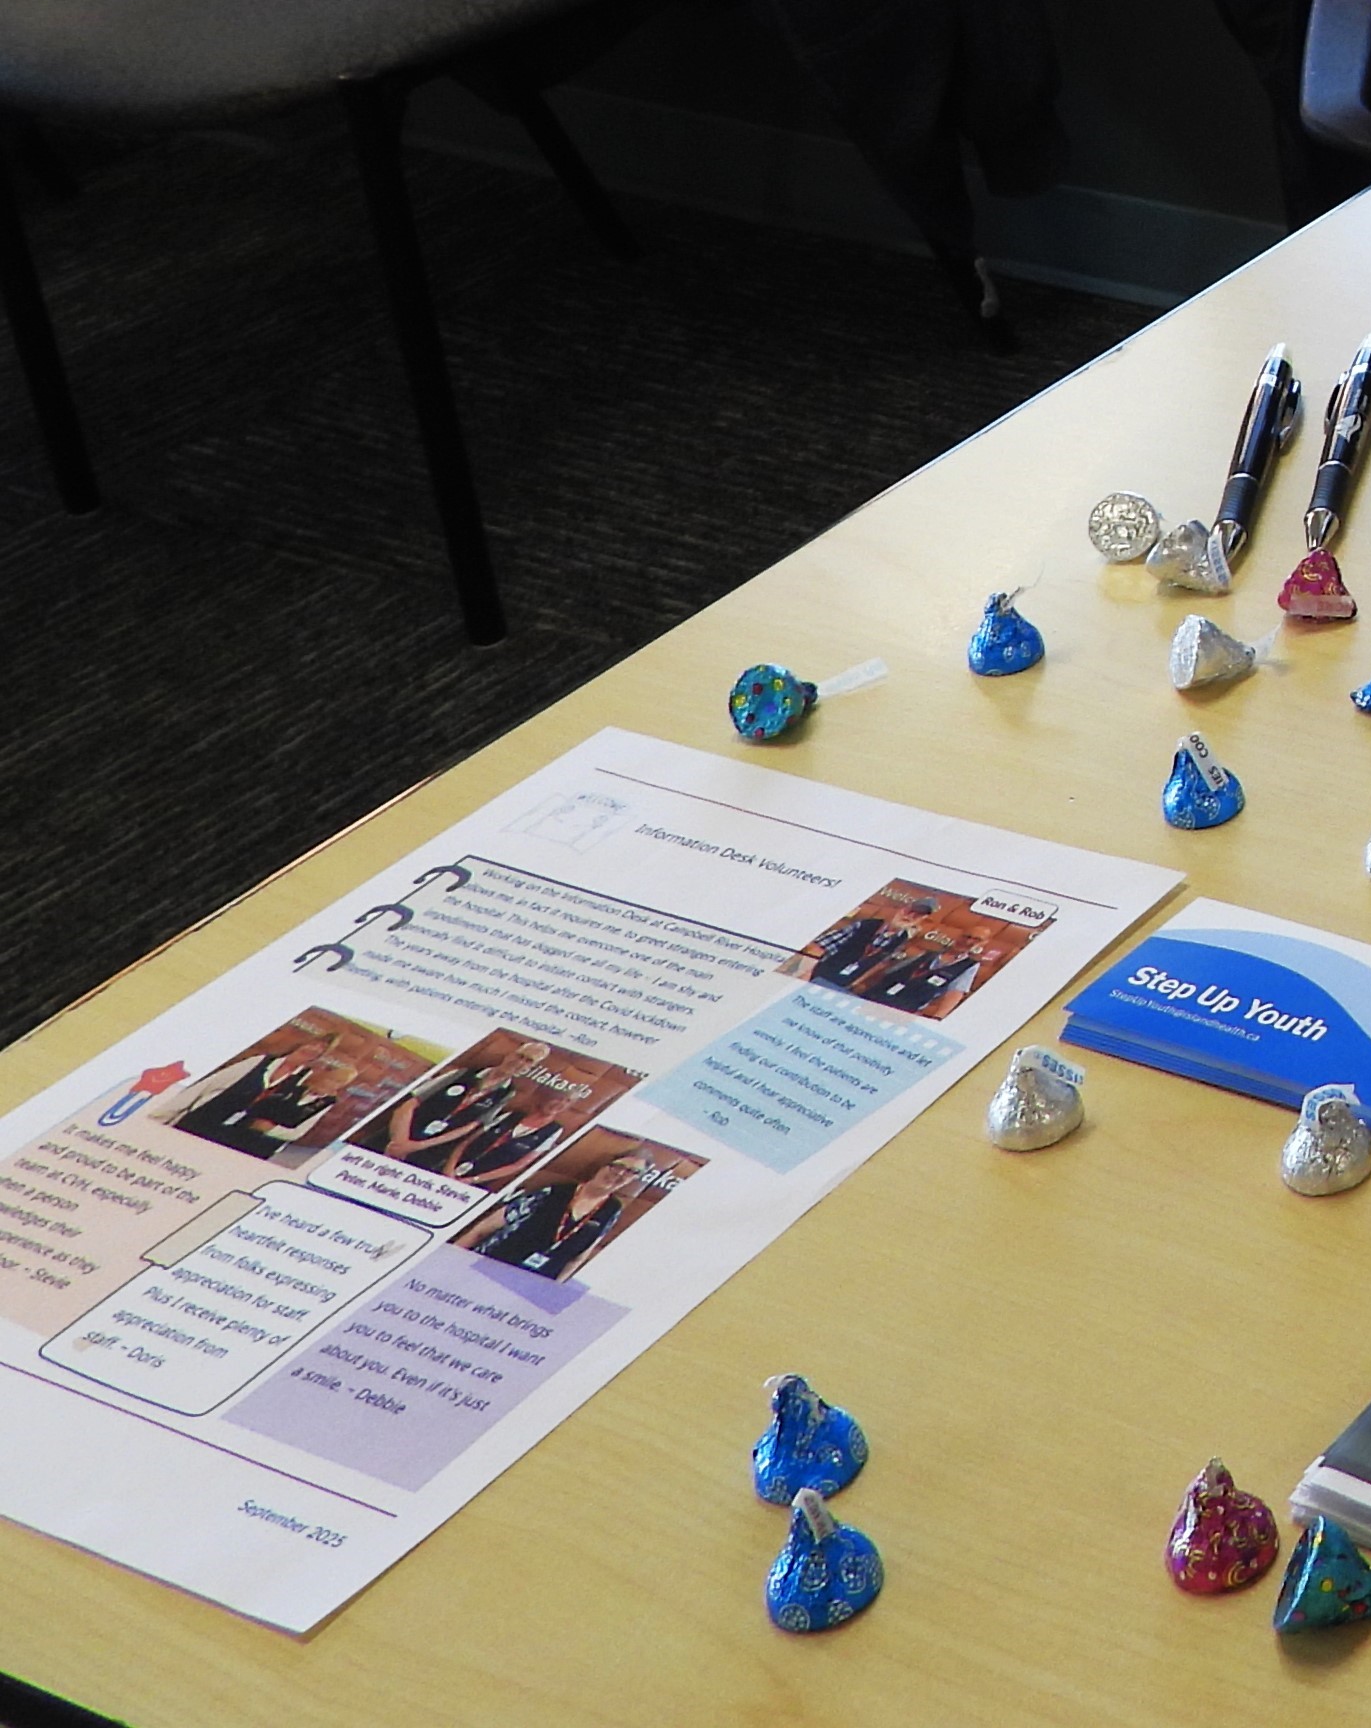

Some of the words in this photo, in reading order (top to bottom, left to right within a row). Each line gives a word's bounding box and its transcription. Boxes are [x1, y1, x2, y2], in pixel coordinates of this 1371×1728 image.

[634, 823, 720, 854] Information
[719, 847, 756, 864] Desk
[980, 897, 1007, 910] Ron
[1006, 903, 1020, 913] &
[1018, 906, 1045, 923] Rob
[1127, 966, 1197, 1000] Step
[1196, 985, 1240, 1013] Up
[1243, 998, 1327, 1041] Youth
[341, 1152, 364, 1166] left
[360, 1159, 375, 1169] to
[401, 1192, 443, 1212] Debbie
[229, 1222, 287, 1252] heartfelt
[282, 1246, 351, 1275] responses
[256, 1202, 282, 1220] I've
[279, 1213, 324, 1237] heard
[318, 1228, 331, 1237] a
[328, 1230, 356, 1246] few
[353, 1240, 388, 1258] truly
[171, 1267, 253, 1302] appreciation
[251, 1295, 275, 1309] for
[201, 1242, 235, 1263] from
[233, 1256, 266, 1275] folks
[264, 1270, 337, 1303] expressing
[143, 1286, 174, 1304] Plus
[169, 1296, 184, 1308] I
[178, 1297, 228, 1329] receive
[222, 1320, 271, 1342] plenty
[268, 1335, 290, 1345] of
[371, 1301, 404, 1315] you
[401, 1309, 421, 1322] to
[419, 1314, 445, 1330] the
[443, 1322, 504, 1350] hospital
[498, 1342, 512, 1354] I
[507, 1347, 546, 1366] want
[404, 1278, 427, 1292] No
[424, 1287, 473, 1308] matter
[471, 1304, 510, 1322] what
[506, 1314, 554, 1338] brings
[112, 1310, 195, 1346] appreciation
[193, 1338, 229, 1359] from
[126, 1346, 166, 1368] Doris
[344, 1322, 377, 1337] you
[375, 1330, 393, 1343] to
[391, 1335, 424, 1352] feel
[418, 1346, 451, 1364] that
[448, 1358, 472, 1372] we
[470, 1366, 503, 1383] care
[290, 1367, 304, 1377] a
[301, 1371, 342, 1392] smile.
[354, 1388, 406, 1415] Debbie
[319, 1344, 364, 1369] about
[355, 1355, 389, 1374] you.
[390, 1368, 428, 1388] Even
[425, 1382, 444, 1392] if
[438, 1387, 463, 1406] it's
[454, 1395, 491, 1412] just
[237, 1499, 309, 1533] September
[305, 1526, 348, 1548] 2025
